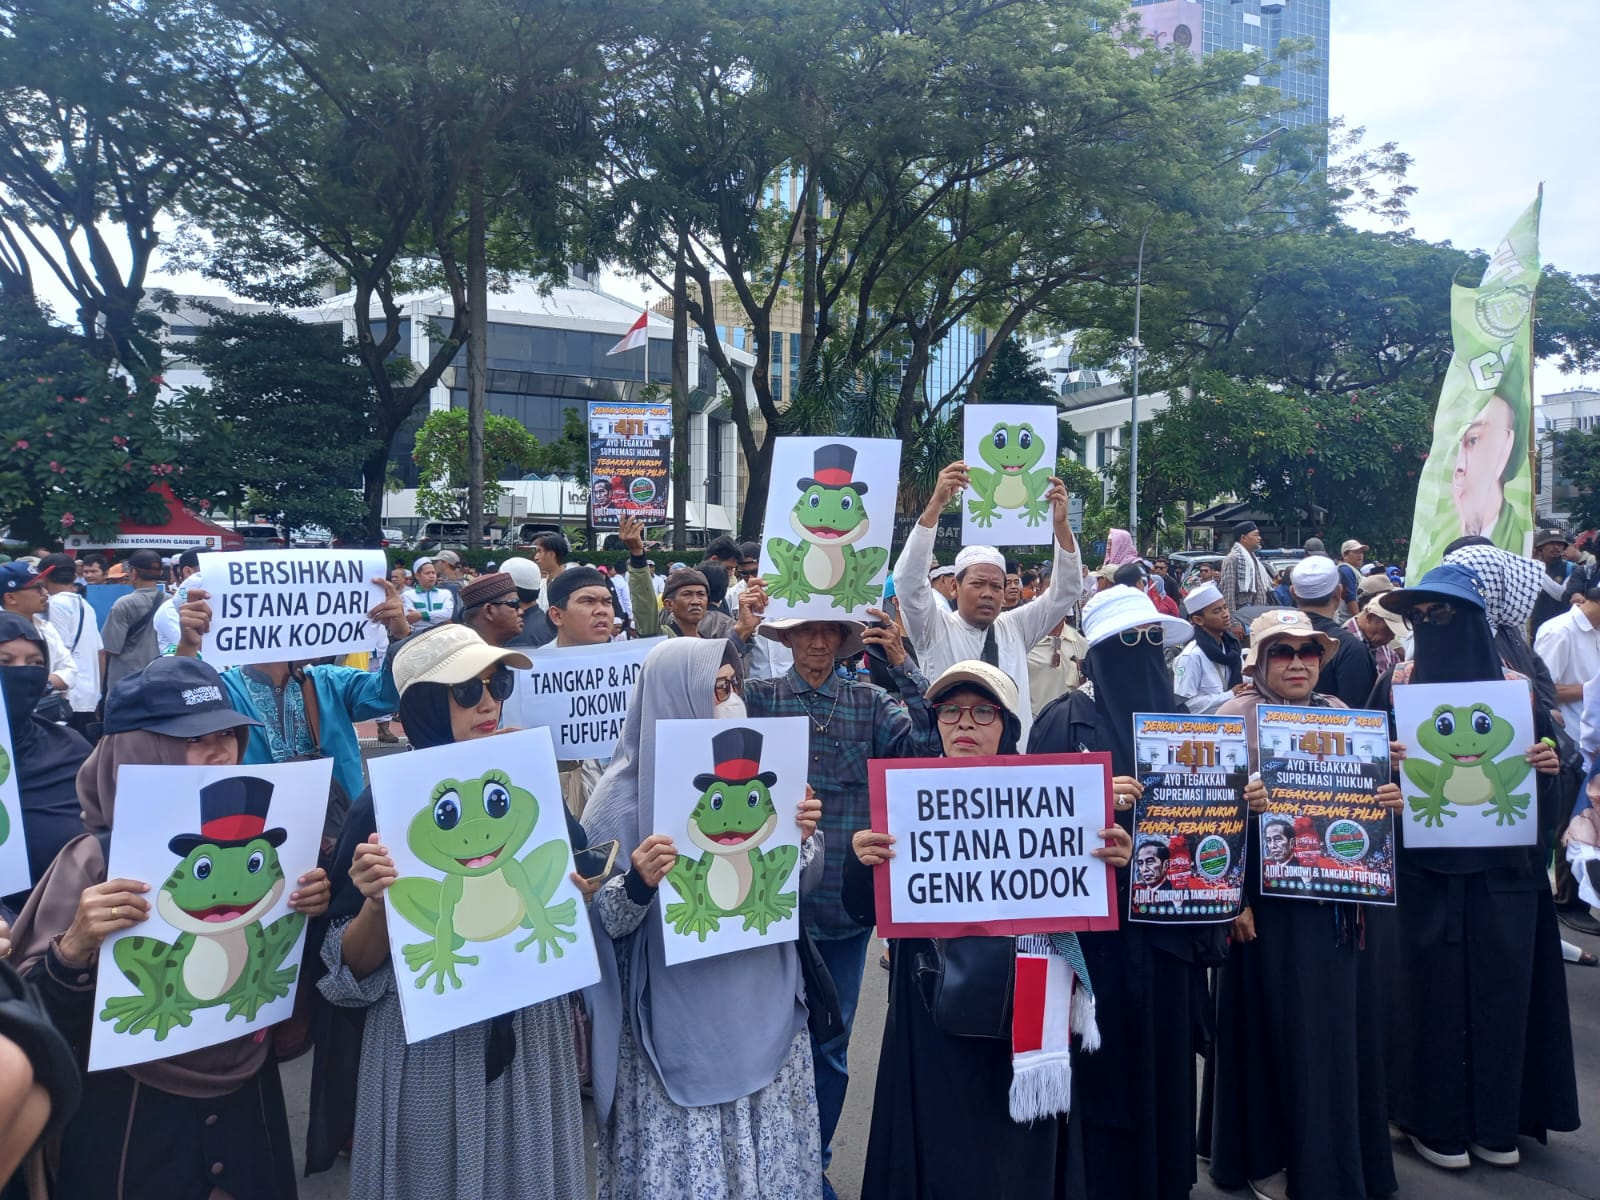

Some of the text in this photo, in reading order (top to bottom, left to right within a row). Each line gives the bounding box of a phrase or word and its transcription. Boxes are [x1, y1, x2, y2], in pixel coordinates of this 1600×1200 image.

[614, 419, 644, 436] 411
[637, 448, 660, 457] HUKUM
[228, 560, 364, 585] BERSIHKAN
[222, 591, 369, 618] ISTANA DARI
[216, 620, 369, 651] GENK KODOK
[531, 668, 604, 694] TANGKAP
[608, 666, 619, 687] &
[569, 691, 626, 718] JOKOWI
[1141, 720, 1179, 733] DENGAN
[1178, 721, 1219, 734] SEMANGAT
[1264, 711, 1384, 728] DENGAN SEMANGAT REUNI
[1299, 730, 1345, 756] 411
[1176, 740, 1216, 767] 411
[1287, 760, 1305, 771] AYO
[1308, 761, 1360, 775] TEGAKKAN
[1164, 774, 1181, 786] AYO
[1183, 774, 1226, 786] TEGAKKAN
[1277, 772, 1373, 789] SUPREMASI HUKUM
[1153, 788, 1235, 801] SUPREMASI HUKUM
[1271, 788, 1333, 801] TEGAKKAN
[917, 786, 1075, 821] BERSIHKAN
[1146, 806, 1239, 817] TEGAKKAN HUKUM
[1302, 805, 1352, 818] TEBANG
[1350, 808, 1387, 821] PILIH
[1138, 821, 1244, 835] TANPA TEBANG PILIH
[910, 826, 1084, 862] ISTANA DARI
[1265, 864, 1391, 887] ADILI JOKOWI & TANGKAP FUFUFAFA
[908, 866, 1090, 904] GENK KODOK
[1155, 889, 1183, 902] JOKOWI
[1191, 889, 1218, 900] TANGKAP
